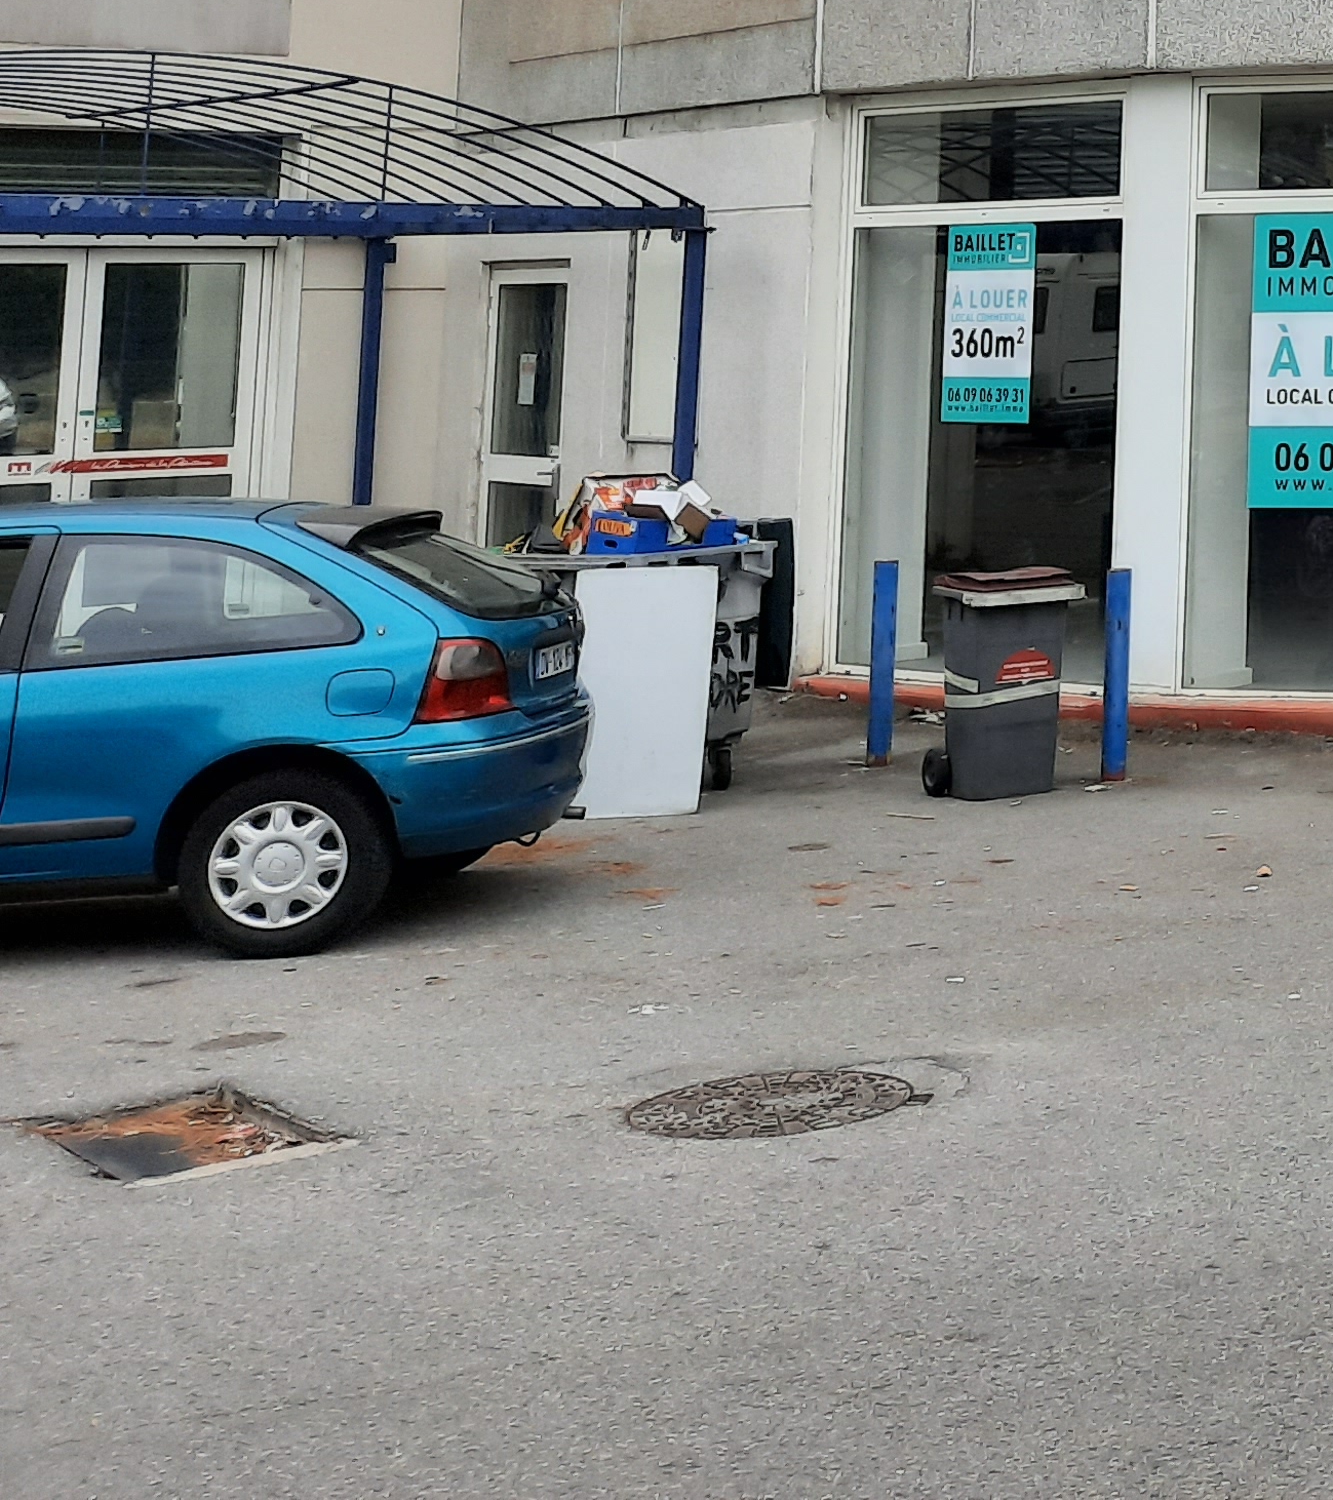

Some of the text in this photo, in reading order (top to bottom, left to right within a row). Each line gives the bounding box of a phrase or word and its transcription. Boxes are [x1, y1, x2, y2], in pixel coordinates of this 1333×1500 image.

[954, 233, 1016, 252] BAILLET
[952, 285, 1028, 309] À LOUER
[1268, 323, 1301, 377] À
[948, 388, 1024, 403] 06 09 06 39 31
[1266, 388, 1323, 405] LOCAL
[1274, 443, 1310, 472] 06
